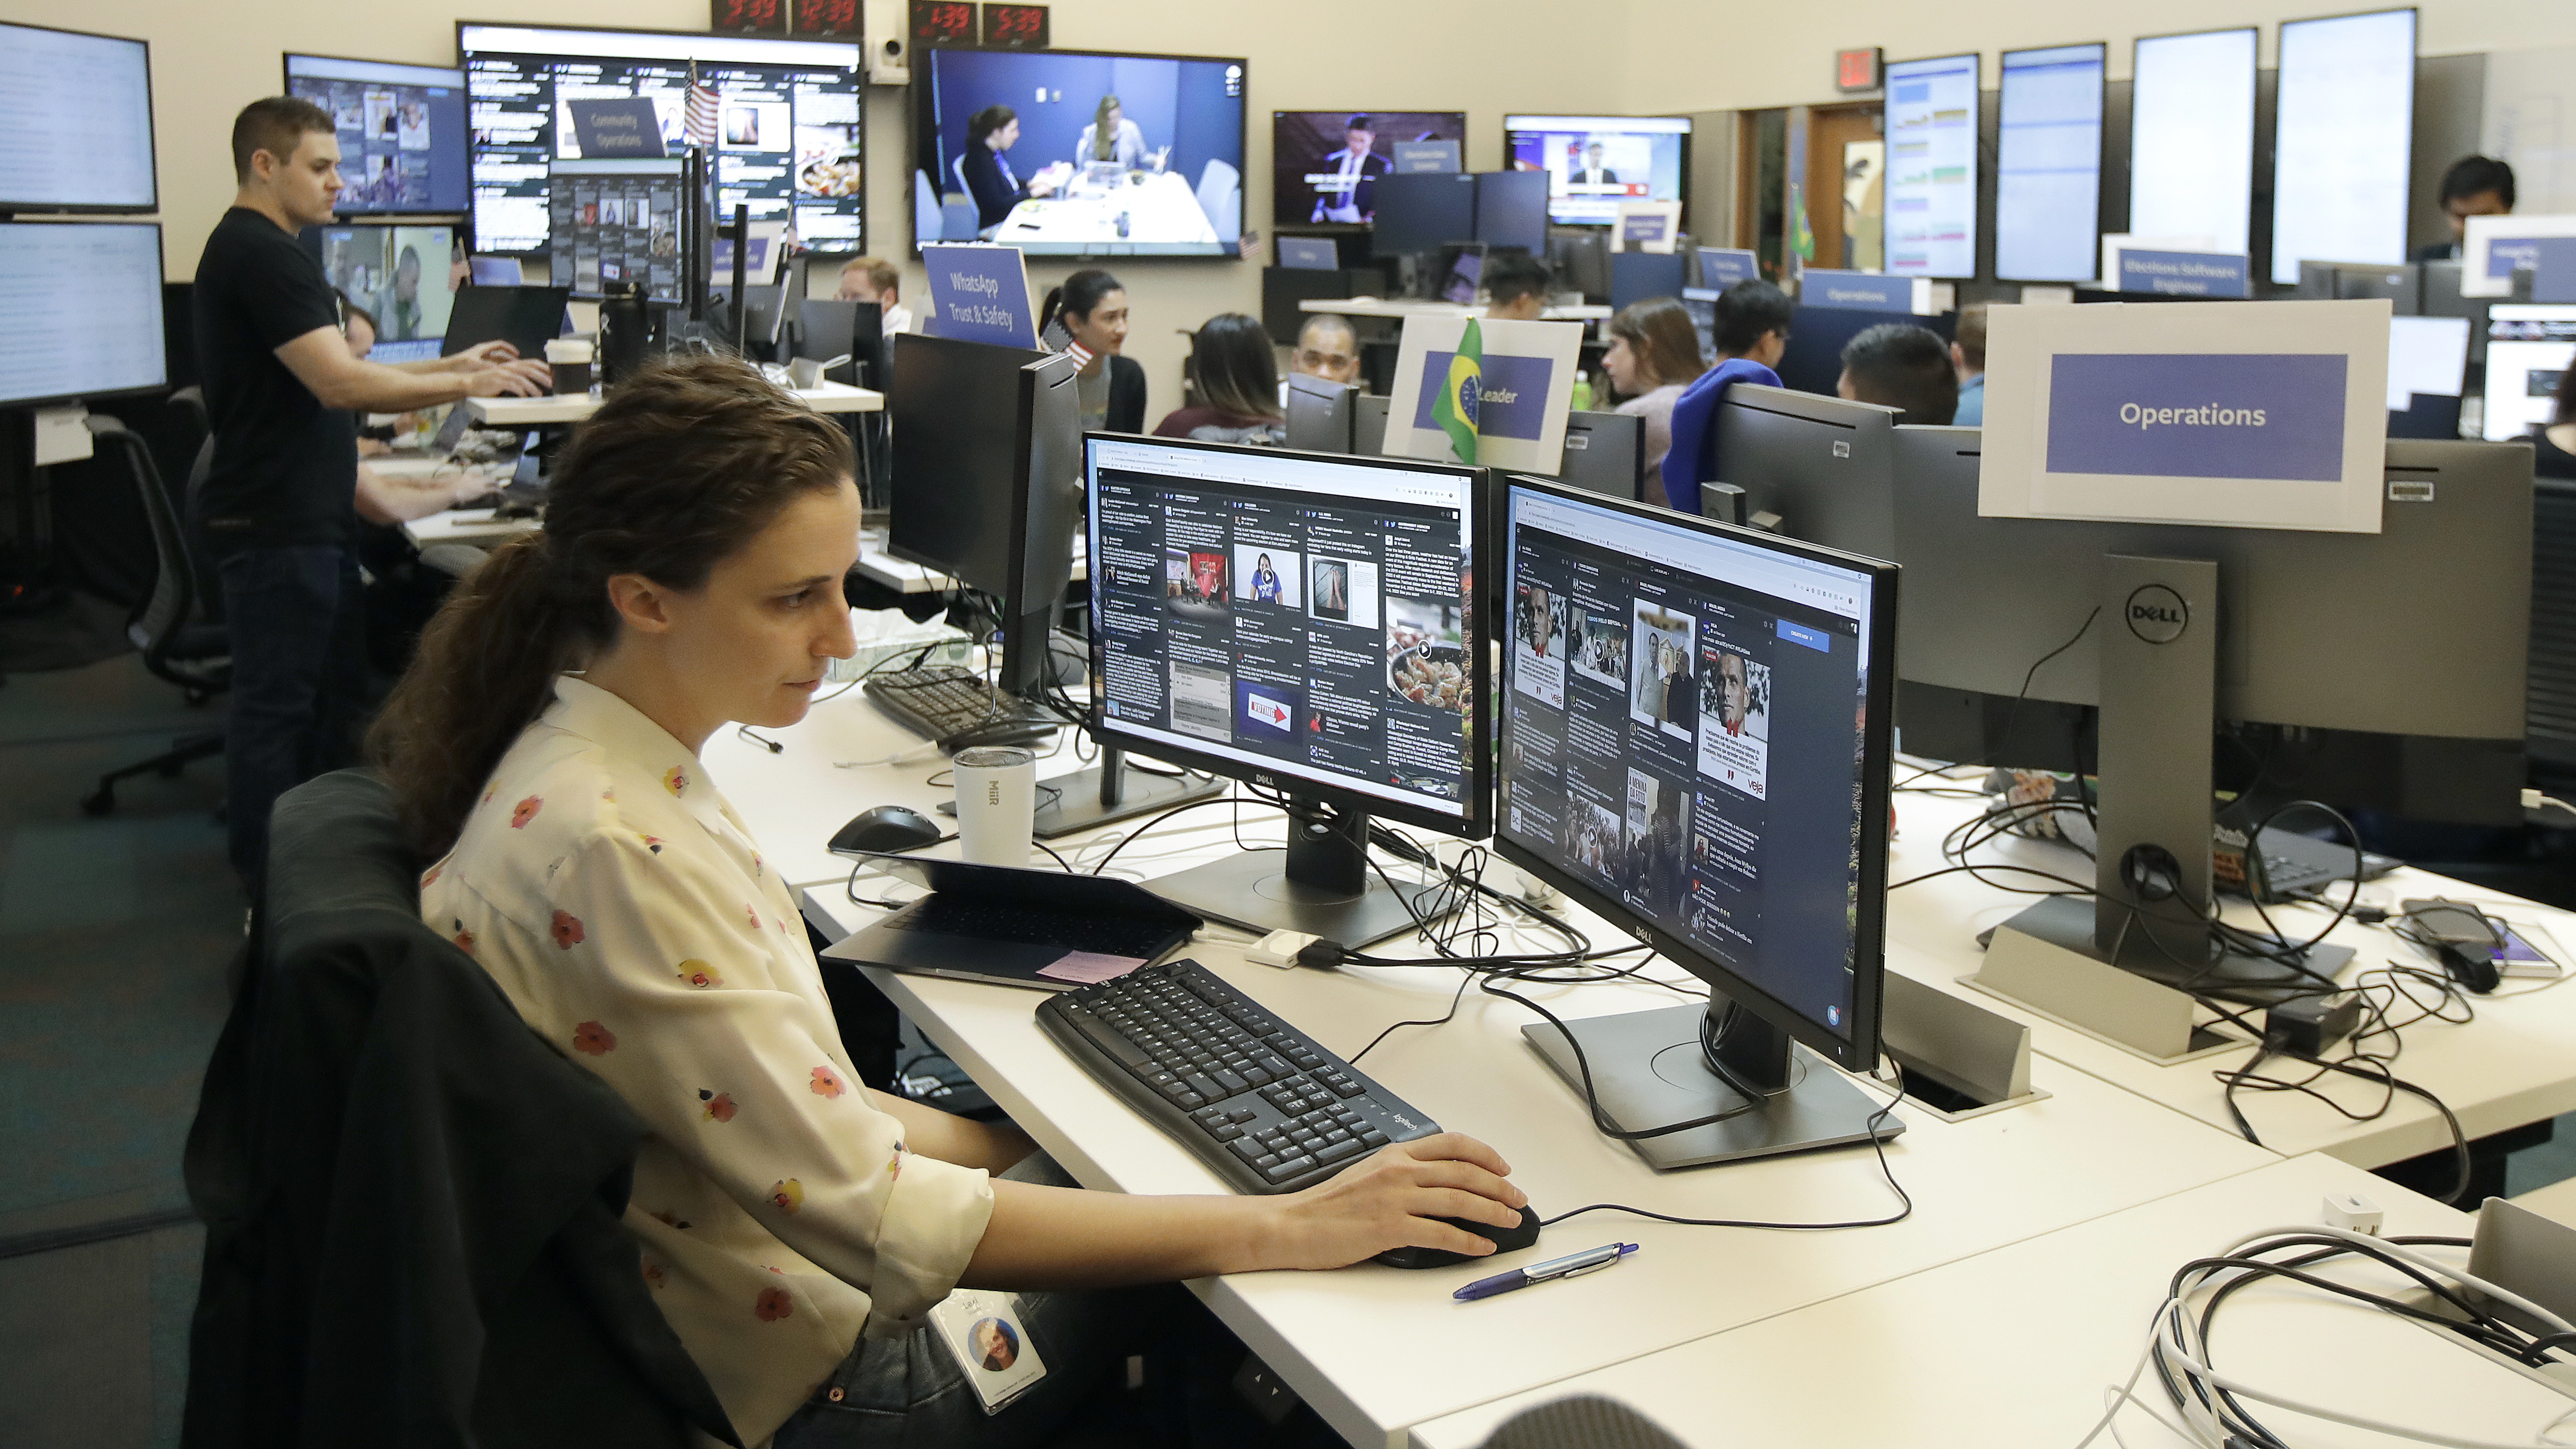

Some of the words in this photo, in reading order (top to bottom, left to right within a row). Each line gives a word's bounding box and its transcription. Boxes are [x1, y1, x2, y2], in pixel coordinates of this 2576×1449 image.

[950, 272, 999, 300] WhatsApp
[949, 303, 973, 323] Trust
[974, 305, 983, 324] &
[983, 305, 1013, 333] Safety
[2120, 402, 2267, 430] Operations
[2132, 605, 2181, 623] DELL
[1551, 693, 1562, 705] veja
[1254, 702, 1275, 718] VOTING
[1256, 774, 1274, 786] DELL
[1747, 779, 1763, 794] veja
[989, 780, 999, 806] MiiR
[1635, 789, 1645, 803] FOTO
[1636, 925, 1653, 944] DELL
[1393, 1113, 1417, 1131] logitech
